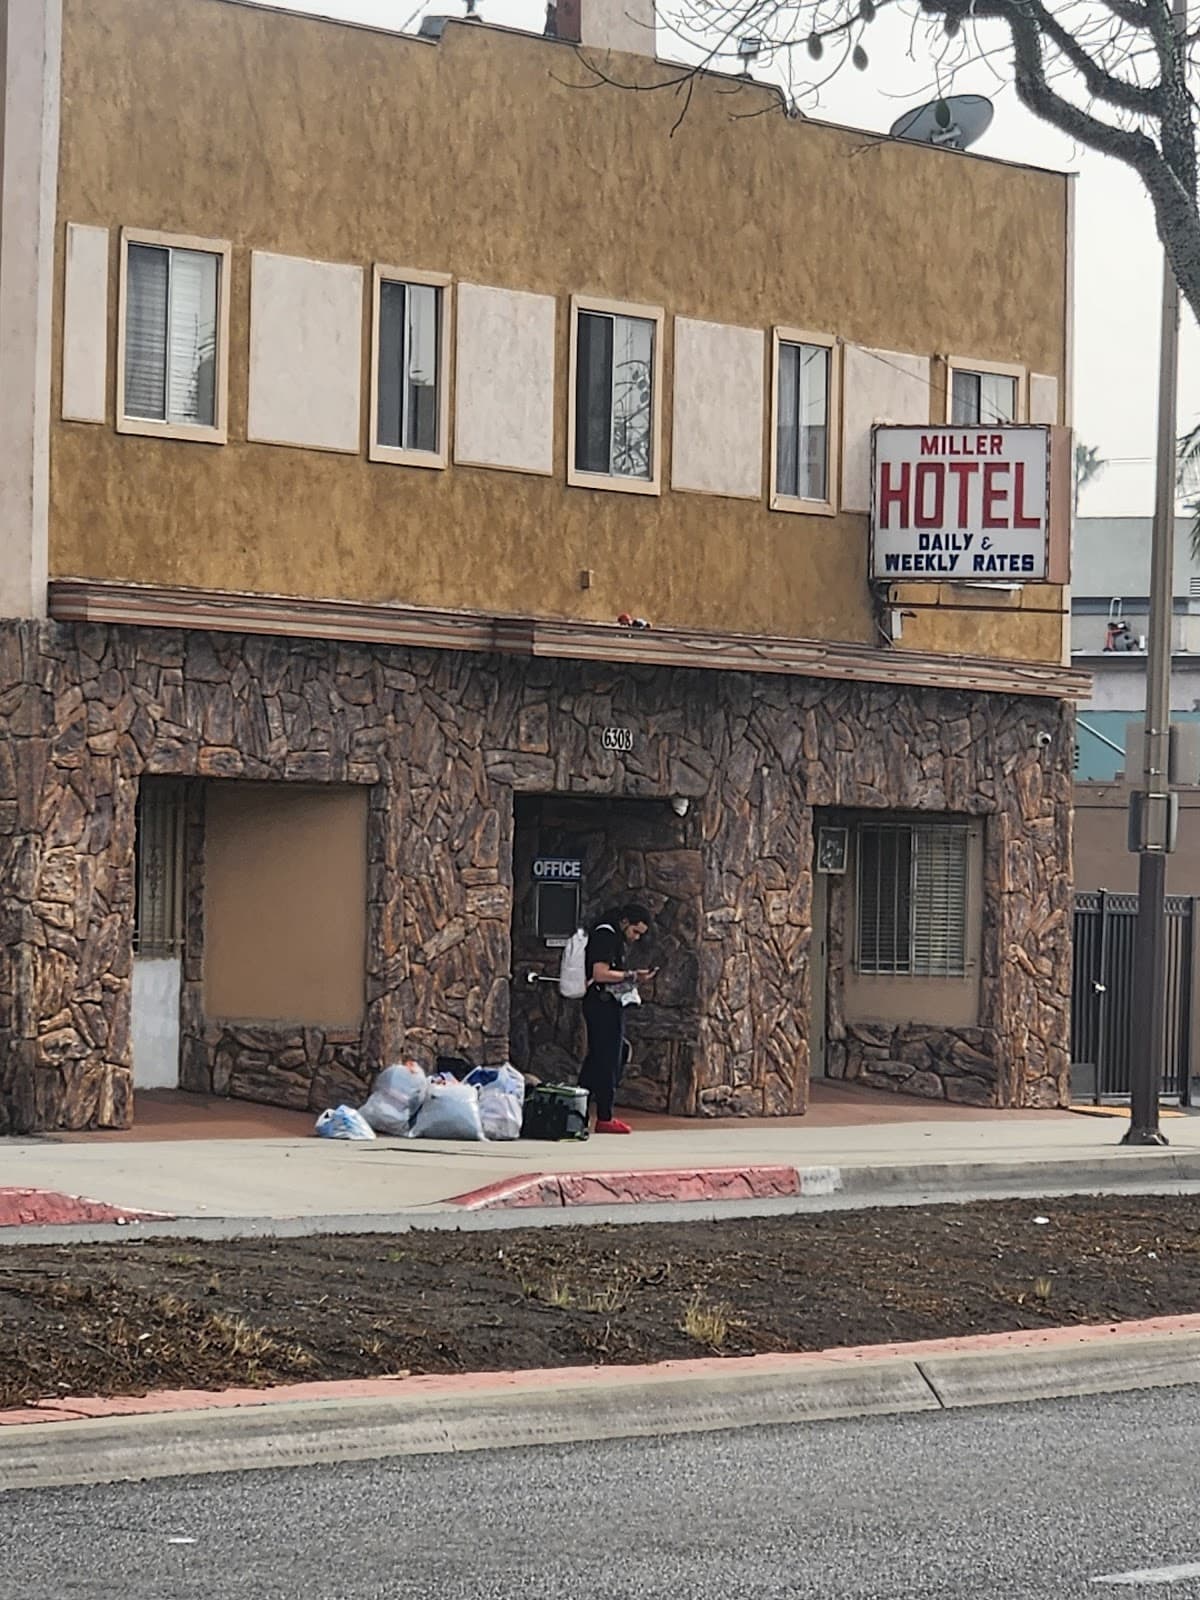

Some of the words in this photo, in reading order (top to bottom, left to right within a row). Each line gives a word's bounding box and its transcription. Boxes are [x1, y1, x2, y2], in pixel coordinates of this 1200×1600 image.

[921, 435, 1003, 455] MILLER
[879, 462, 1041, 529] HOTEL
[918, 533, 974, 551] DAILY
[980, 536, 994, 551] &
[884, 553, 960, 572] WEEKLY
[972, 554, 1035, 572] RATES
[604, 728, 631, 749] 6308
[533, 860, 581, 876] OFFICE
